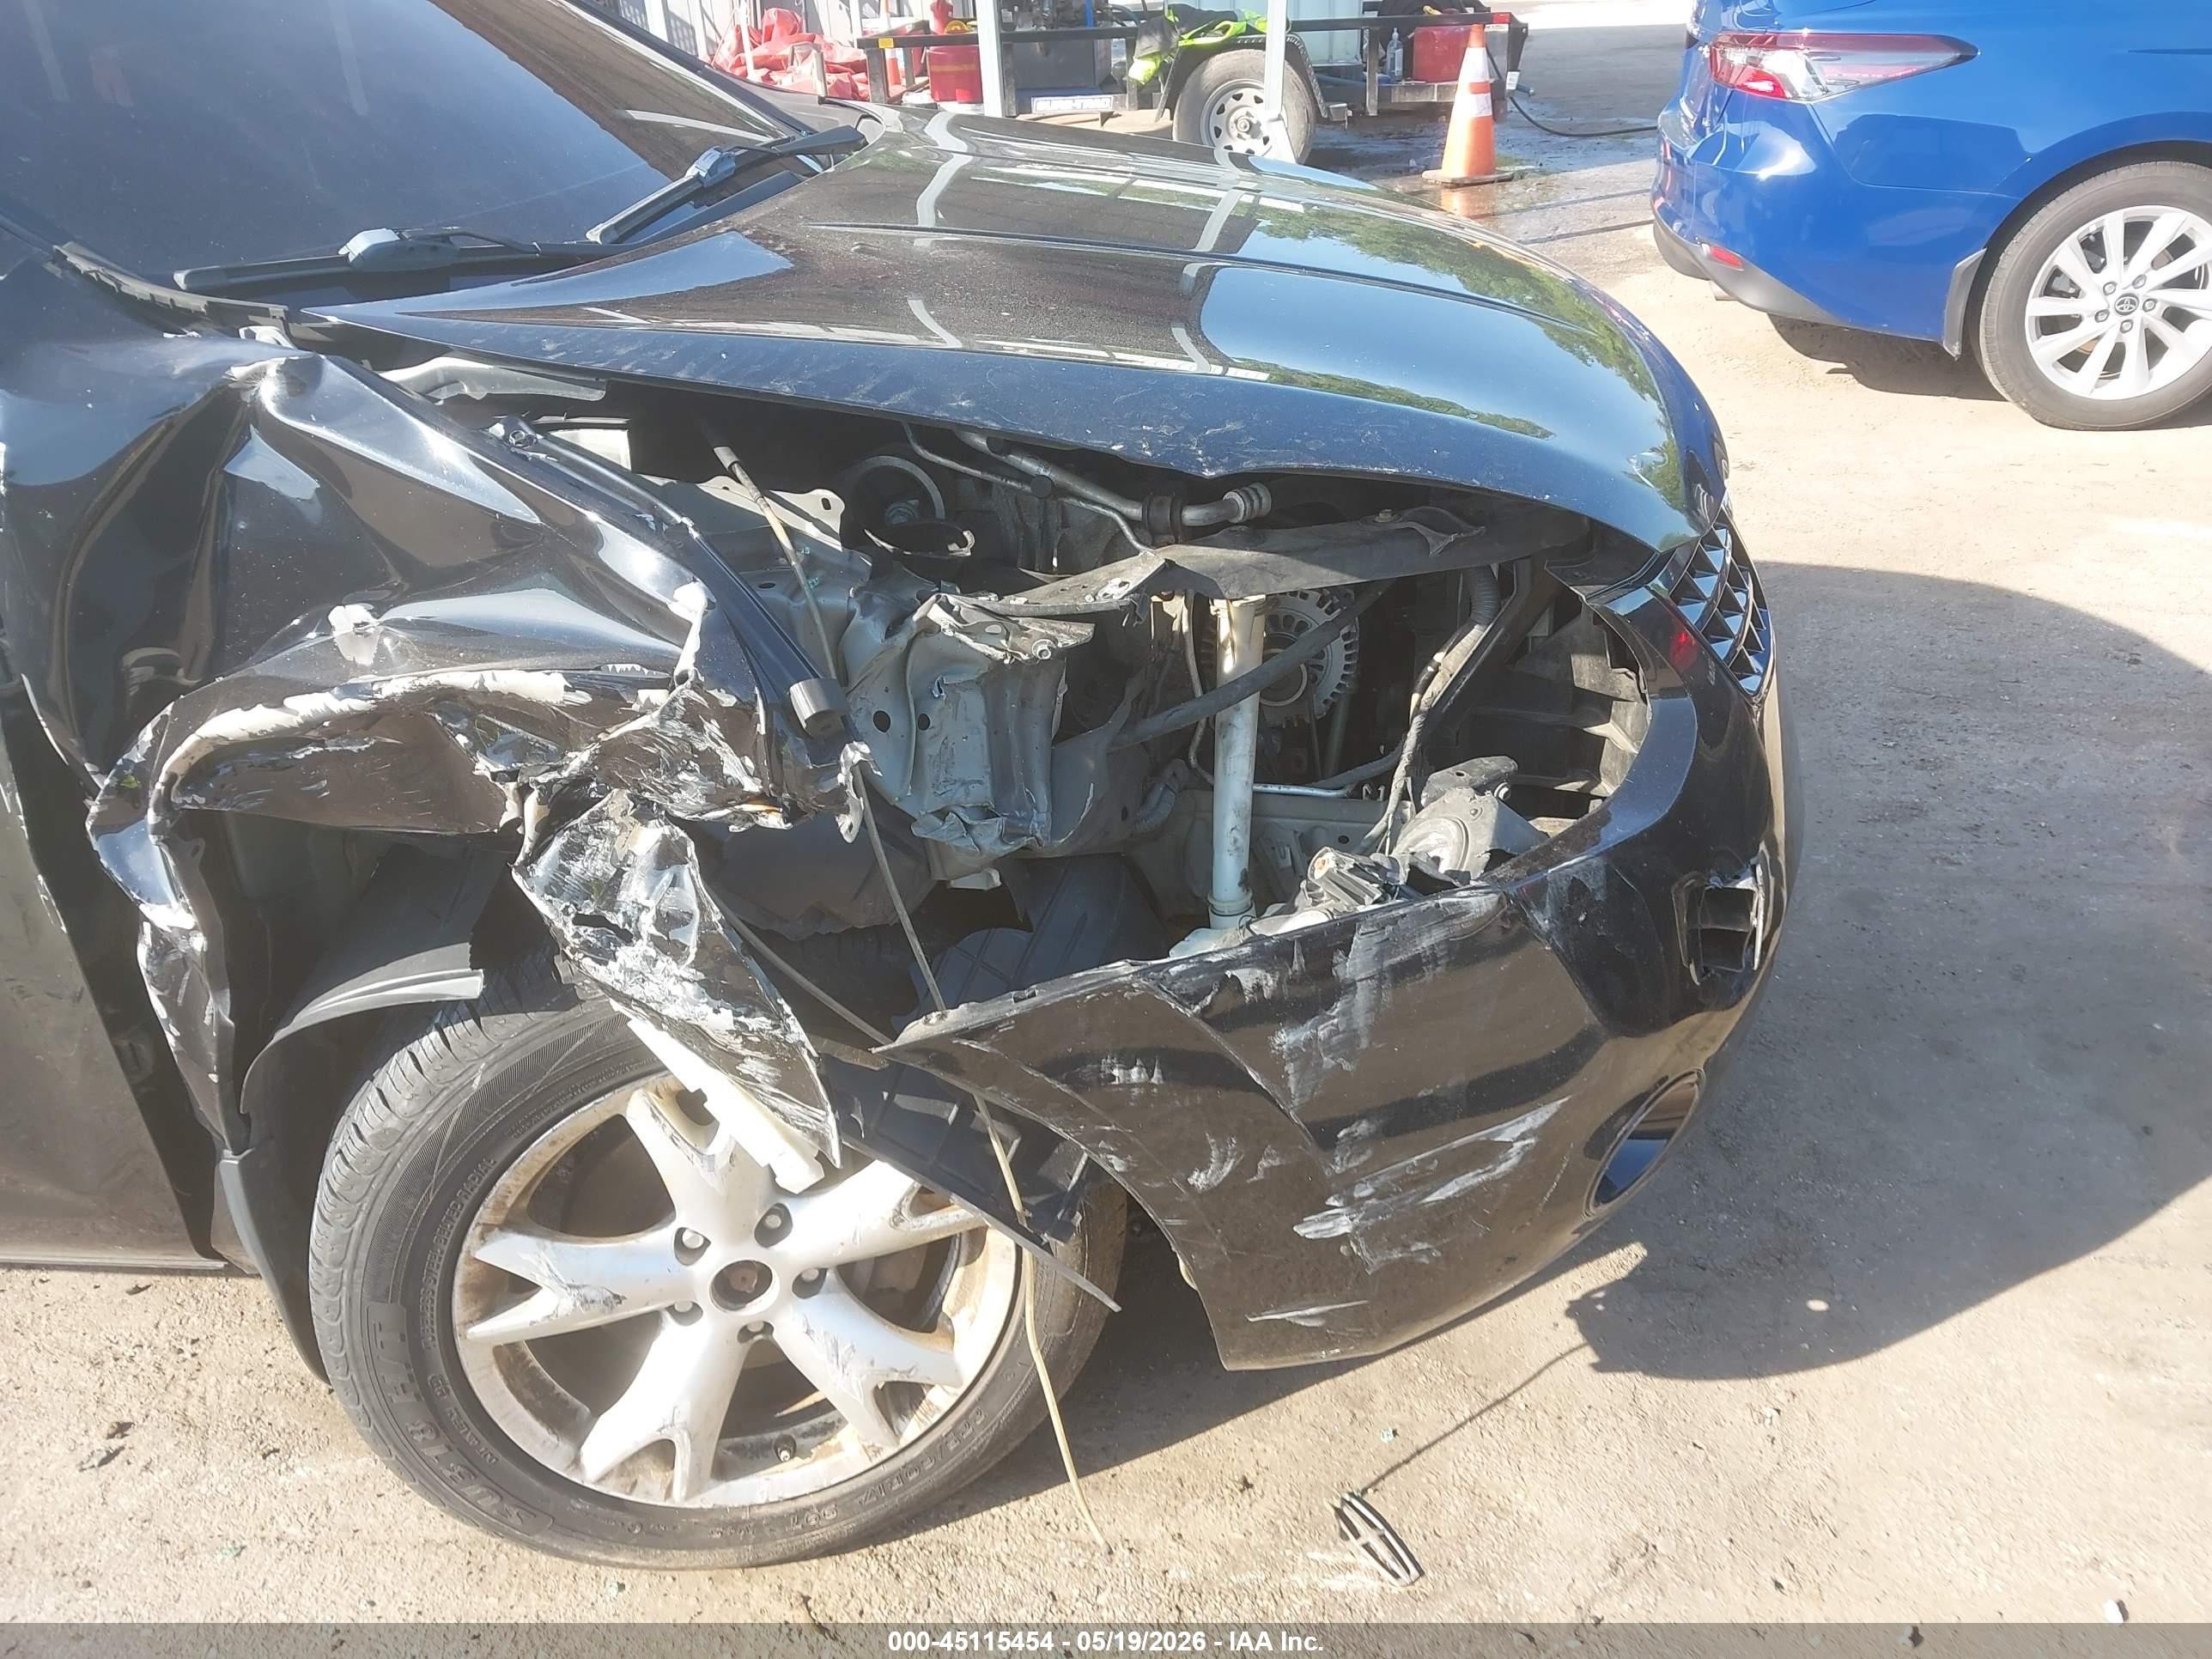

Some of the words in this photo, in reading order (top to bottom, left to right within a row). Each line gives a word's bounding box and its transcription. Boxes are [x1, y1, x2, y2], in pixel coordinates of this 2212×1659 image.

[421, 1249, 441, 1288] STEEL
[433, 1200, 462, 1246] BELTED
[456, 1158, 496, 1200] RADIAL
